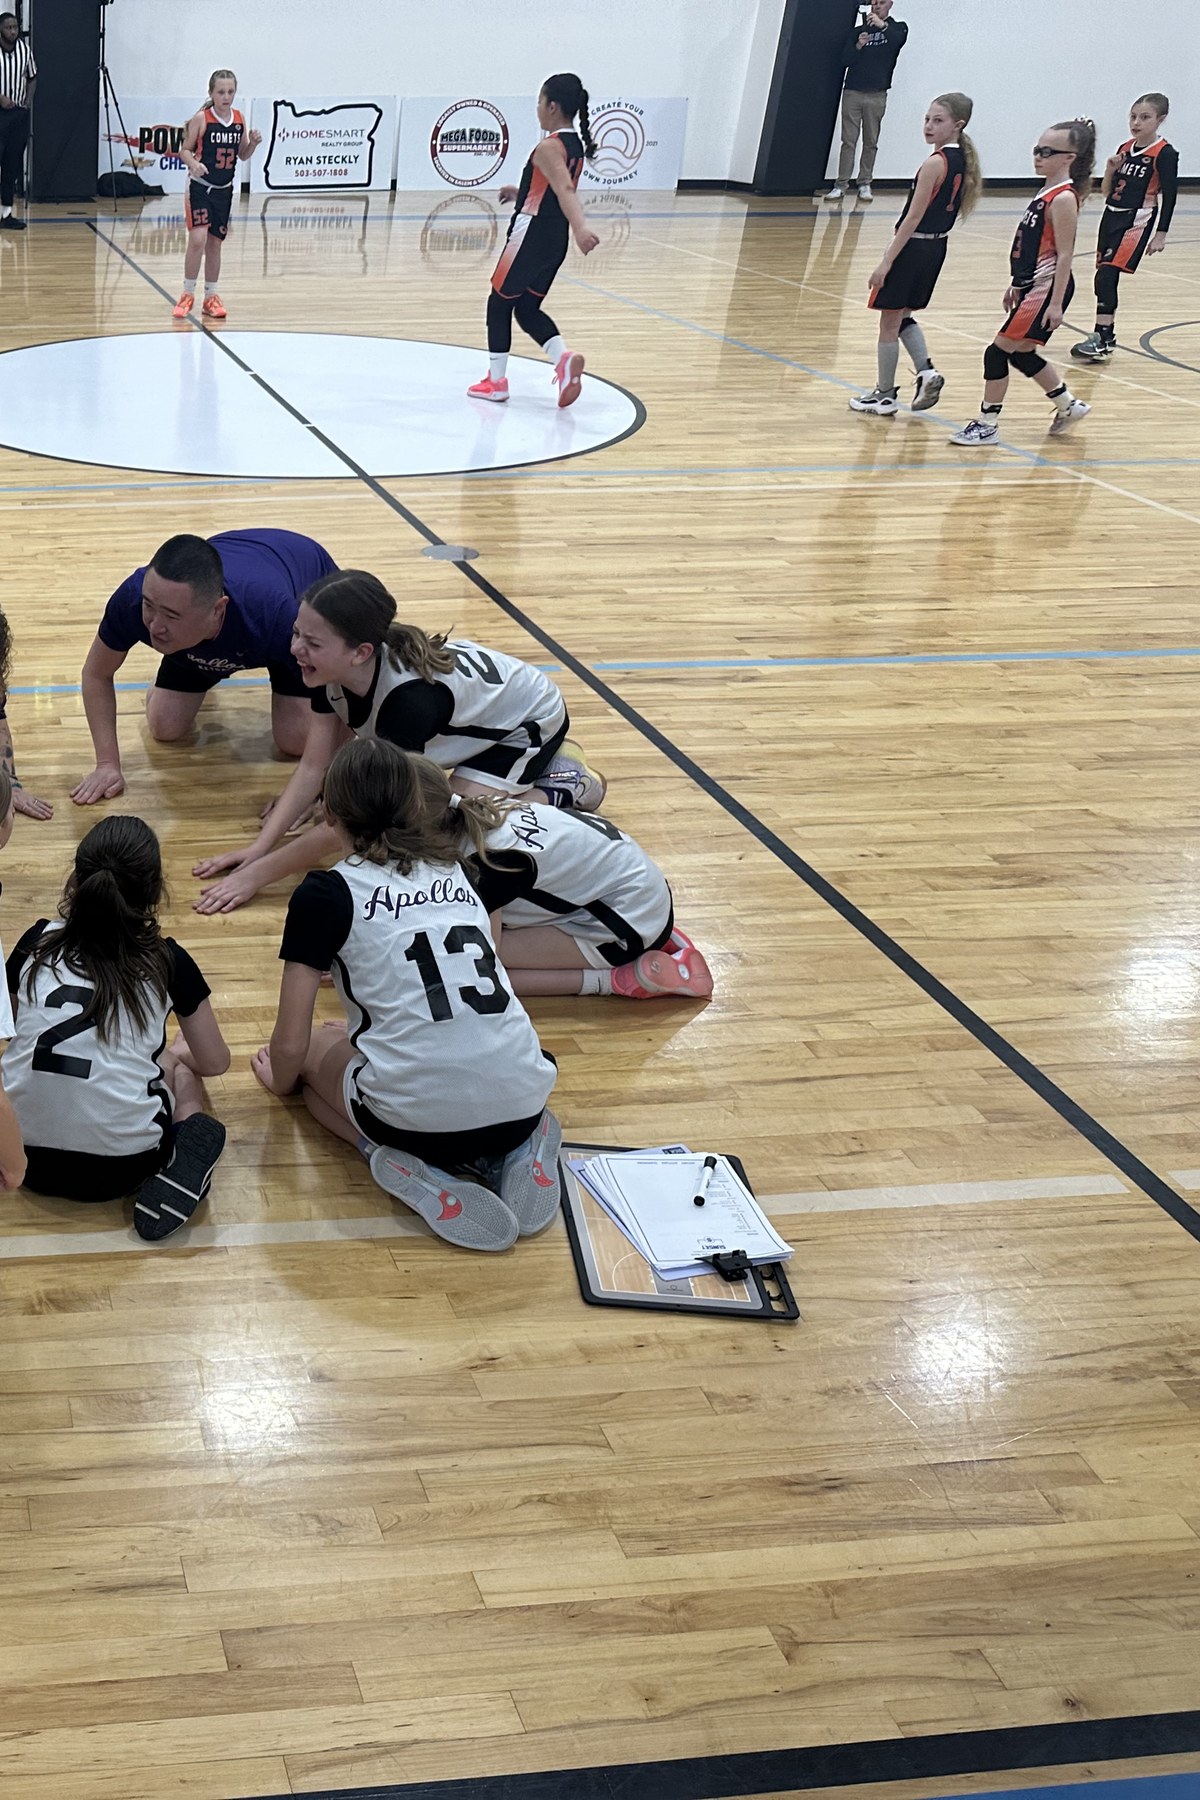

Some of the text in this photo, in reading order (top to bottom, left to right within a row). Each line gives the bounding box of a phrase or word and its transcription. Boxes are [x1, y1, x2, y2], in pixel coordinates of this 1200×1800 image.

[456, 100, 478, 109] OWNED
[591, 101, 644, 116] CREATE YOUR
[210, 132, 242, 144] COMETS
[292, 129, 365, 139] HOMESMART
[440, 128, 501, 142] MEGA FOODS
[215, 147, 235, 169] 52
[285, 154, 359, 165] RYAN STECKLY
[295, 169, 348, 177] 503-507-1808
[583, 170, 600, 182] OWN
[602, 170, 638, 184] JOURNEY
[193, 208, 209, 225] 52
[363, 878, 478, 921] Apollos
[404, 925, 510, 1022] 13
[32, 984, 98, 1079] 2
